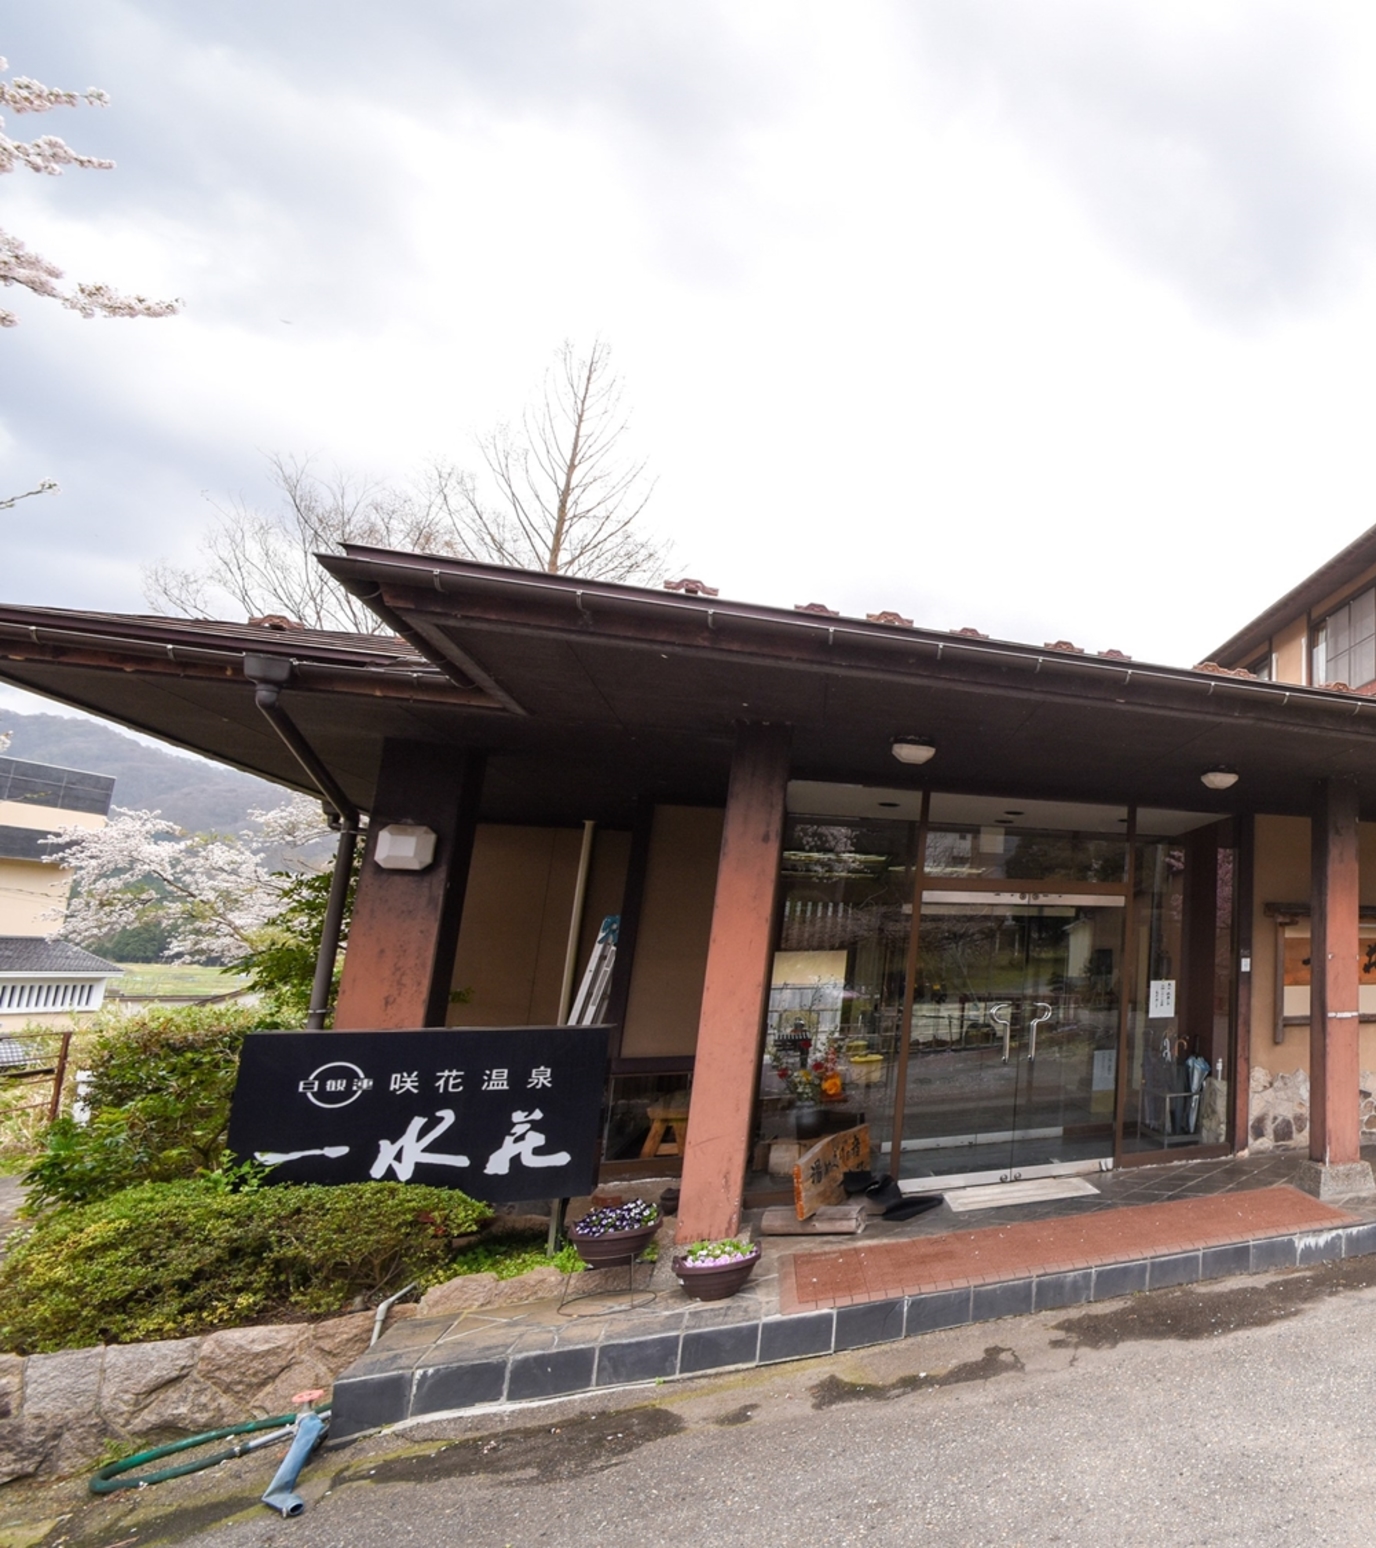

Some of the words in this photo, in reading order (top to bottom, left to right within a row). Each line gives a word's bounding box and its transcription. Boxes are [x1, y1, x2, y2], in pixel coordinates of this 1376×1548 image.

[390, 1066, 553, 1095] 咲花温泉
[254, 1109, 571, 1181] 一水花
